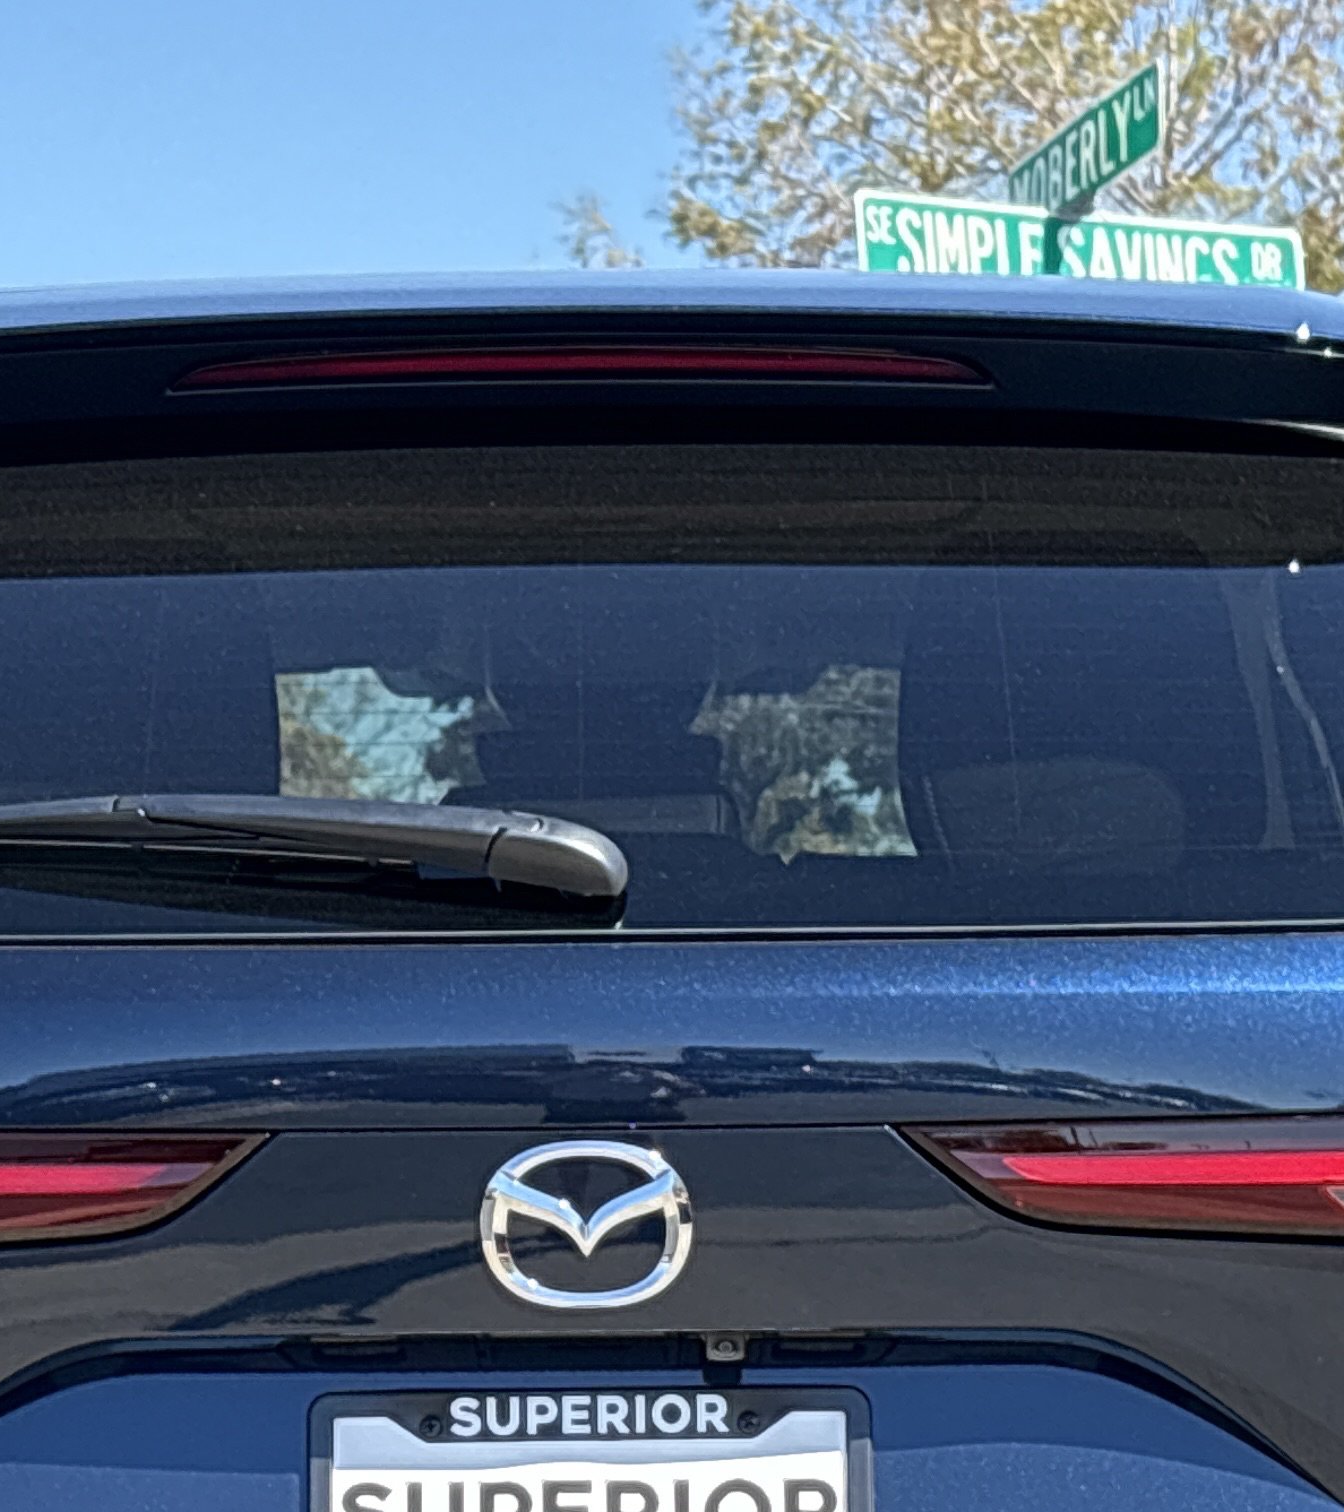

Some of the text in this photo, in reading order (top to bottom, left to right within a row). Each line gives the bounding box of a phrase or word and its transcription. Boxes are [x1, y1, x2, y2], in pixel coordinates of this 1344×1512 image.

[866, 206, 1284, 287] SE SIMPLE SAVINGS DR
[449, 1393, 730, 1437] SUPERIOR
